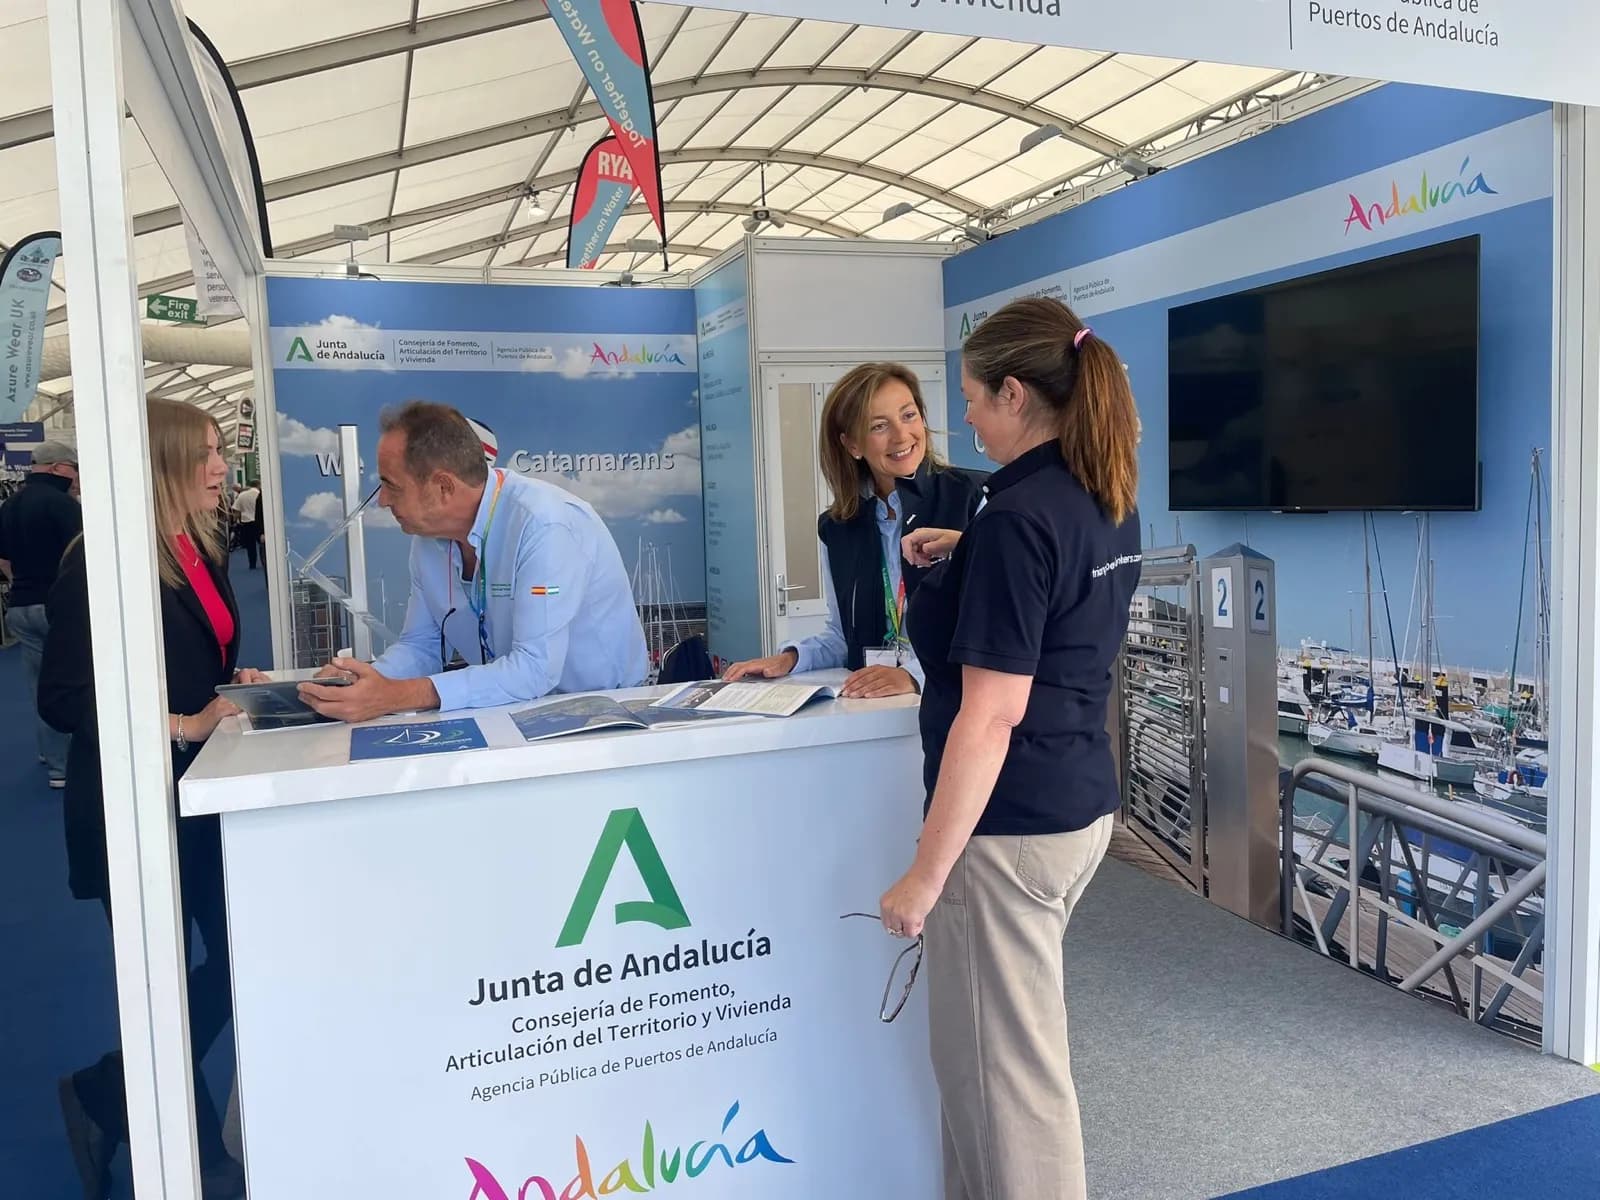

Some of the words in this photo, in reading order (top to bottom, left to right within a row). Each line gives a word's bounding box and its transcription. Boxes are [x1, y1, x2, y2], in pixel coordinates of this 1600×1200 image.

[1309, 2, 1381, 30] Puertos
[1387, 11, 1409, 34] de
[1413, 16, 1498, 46] Andalucía
[598, 151, 633, 180] RYA
[601, 186, 624, 217] Water
[1344, 155, 1498, 236] Andalucía
[596, 219, 608, 232] on
[578, 232, 600, 270] ogether
[9, 298, 25, 319] UK
[167, 310, 189, 320] exit
[168, 300, 190, 311] Fire
[6, 323, 23, 359] Wear
[316, 339, 347, 349] Junta
[317, 350, 330, 360] de
[333, 350, 385, 361] Andalucía
[437, 339, 446, 347] de
[442, 348, 453, 356] del
[591, 342, 686, 366] Andalucía
[6, 364, 18, 403] Azure
[513, 449, 676, 473] Catamarans
[1217, 578, 1228, 617] 2
[1255, 579, 1265, 620] 2
[468, 969, 563, 1006] Junta
[574, 959, 612, 988] de
[620, 928, 771, 980] Andalucía
[512, 999, 614, 1033] Consejería
[620, 996, 643, 1014] de
[649, 983, 735, 1009] Fomento,
[445, 1035, 567, 1072] Articulación
[573, 1027, 602, 1048] del
[608, 1012, 697, 1041] Territorio
[702, 1011, 712, 1028] y
[716, 994, 791, 1021] Vivienda
[471, 1077, 535, 1101] Agencia
[539, 1066, 597, 1087] Pública
[601, 1060, 620, 1075] de
[624, 1049, 682, 1070] Puertos
[686, 1044, 704, 1058] de
[707, 1028, 777, 1054] Andalucía
